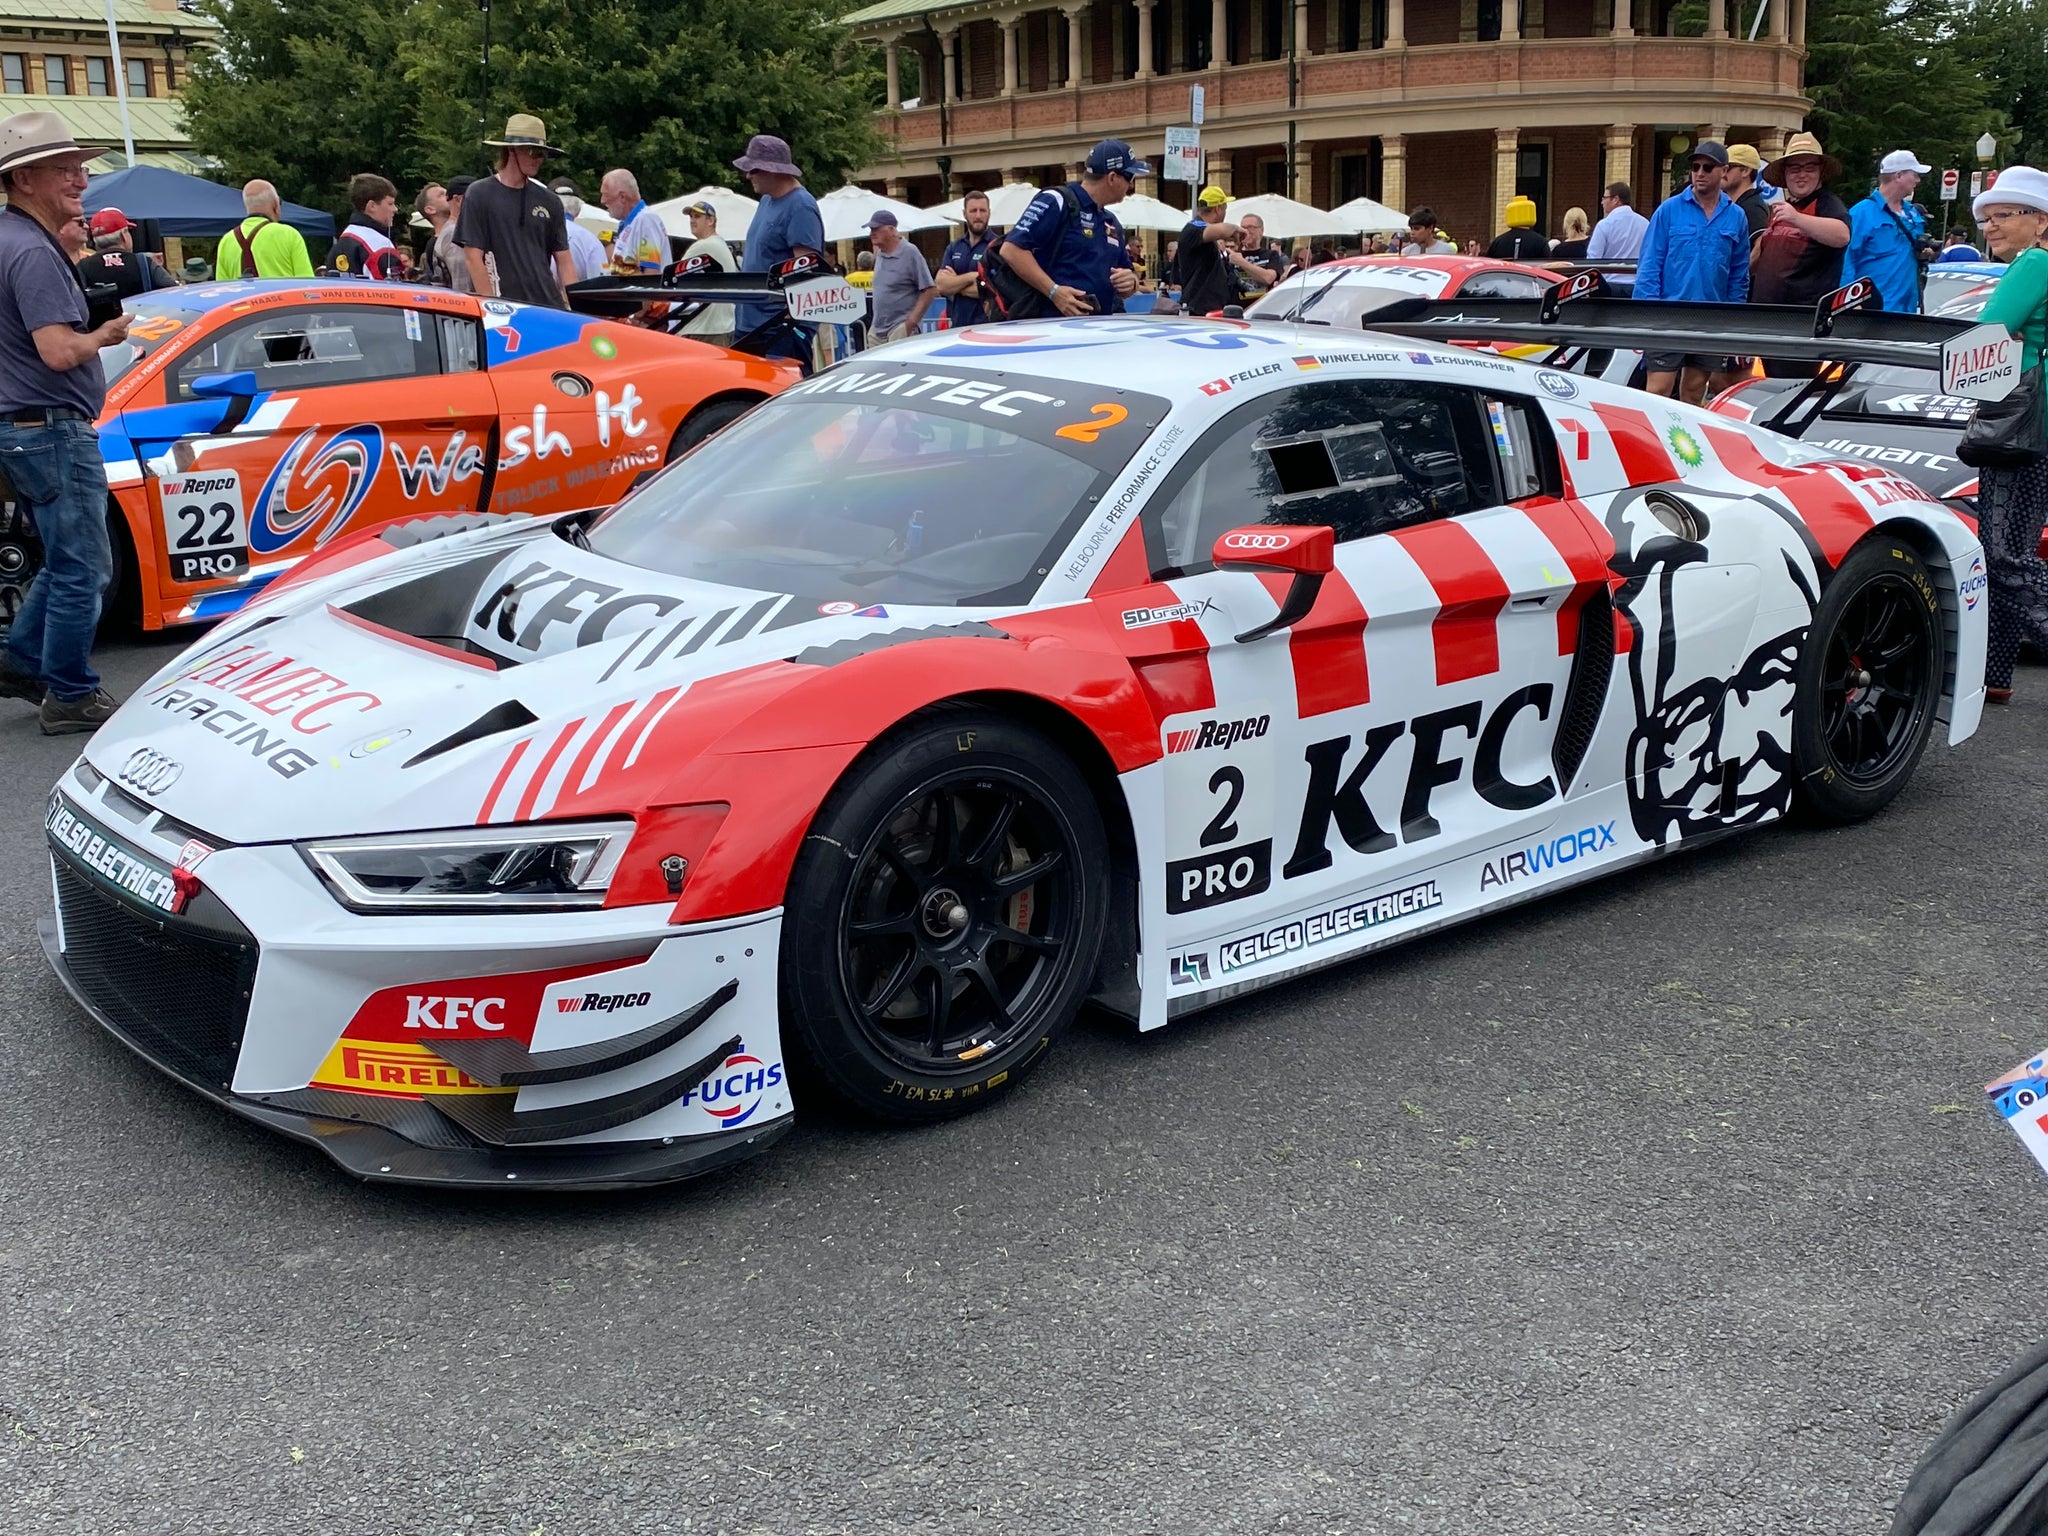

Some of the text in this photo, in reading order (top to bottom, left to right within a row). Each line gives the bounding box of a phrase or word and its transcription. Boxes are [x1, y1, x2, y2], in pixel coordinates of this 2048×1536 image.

[250, 295, 283, 306] HAASE
[321, 291, 342, 299] VAN
[366, 291, 395, 299] LINDE
[432, 297, 467, 306] TALBOT
[796, 286, 850, 316] JAMEC
[803, 302, 858, 317] RACING
[142, 339, 184, 376] PERFORMANCE
[1229, 363, 1282, 384] FELLER
[1318, 352, 1401, 364] WINKELHOCK
[1433, 355, 1516, 373] SCHUMACHER
[1949, 339, 2010, 390] JAMEC
[780, 371, 1056, 417] ANATEC
[1540, 375, 1572, 389] FOX
[1955, 365, 2013, 391] RACING
[389, 383, 648, 499] Wash It
[1055, 403, 1128, 443] 2
[1801, 439, 1958, 472] llmarc
[182, 477, 236, 495] Repco
[495, 445, 660, 509] TRUCK WASHING
[1064, 424, 1185, 582] MELBOURNE PERFORMANCE CENTRE
[177, 502, 235, 549] 22
[183, 554, 236, 577] PRO
[1960, 574, 1987, 596] FUCHS
[474, 561, 684, 652] KFC
[144, 645, 382, 735] JAMEC
[151, 688, 319, 780] RACING
[956, 732, 976, 751] LF
[1194, 714, 1271, 750] Repco
[1283, 683, 1556, 880] KFC
[1199, 765, 1245, 849] 2
[49, 806, 177, 912] KELSO ELECTRICAL
[1480, 820, 1616, 892] AIRWORX
[1182, 856, 1254, 902] PRO
[1220, 880, 1443, 973] KELSO ELECTRICAL
[403, 995, 506, 1031] KFC
[580, 992, 651, 1013] Repco
[342, 1047, 493, 1089] PIRELL
[682, 1063, 782, 1107] FUCHS
[883, 1080, 905, 1093] LF
[905, 1086, 924, 1100] W3
